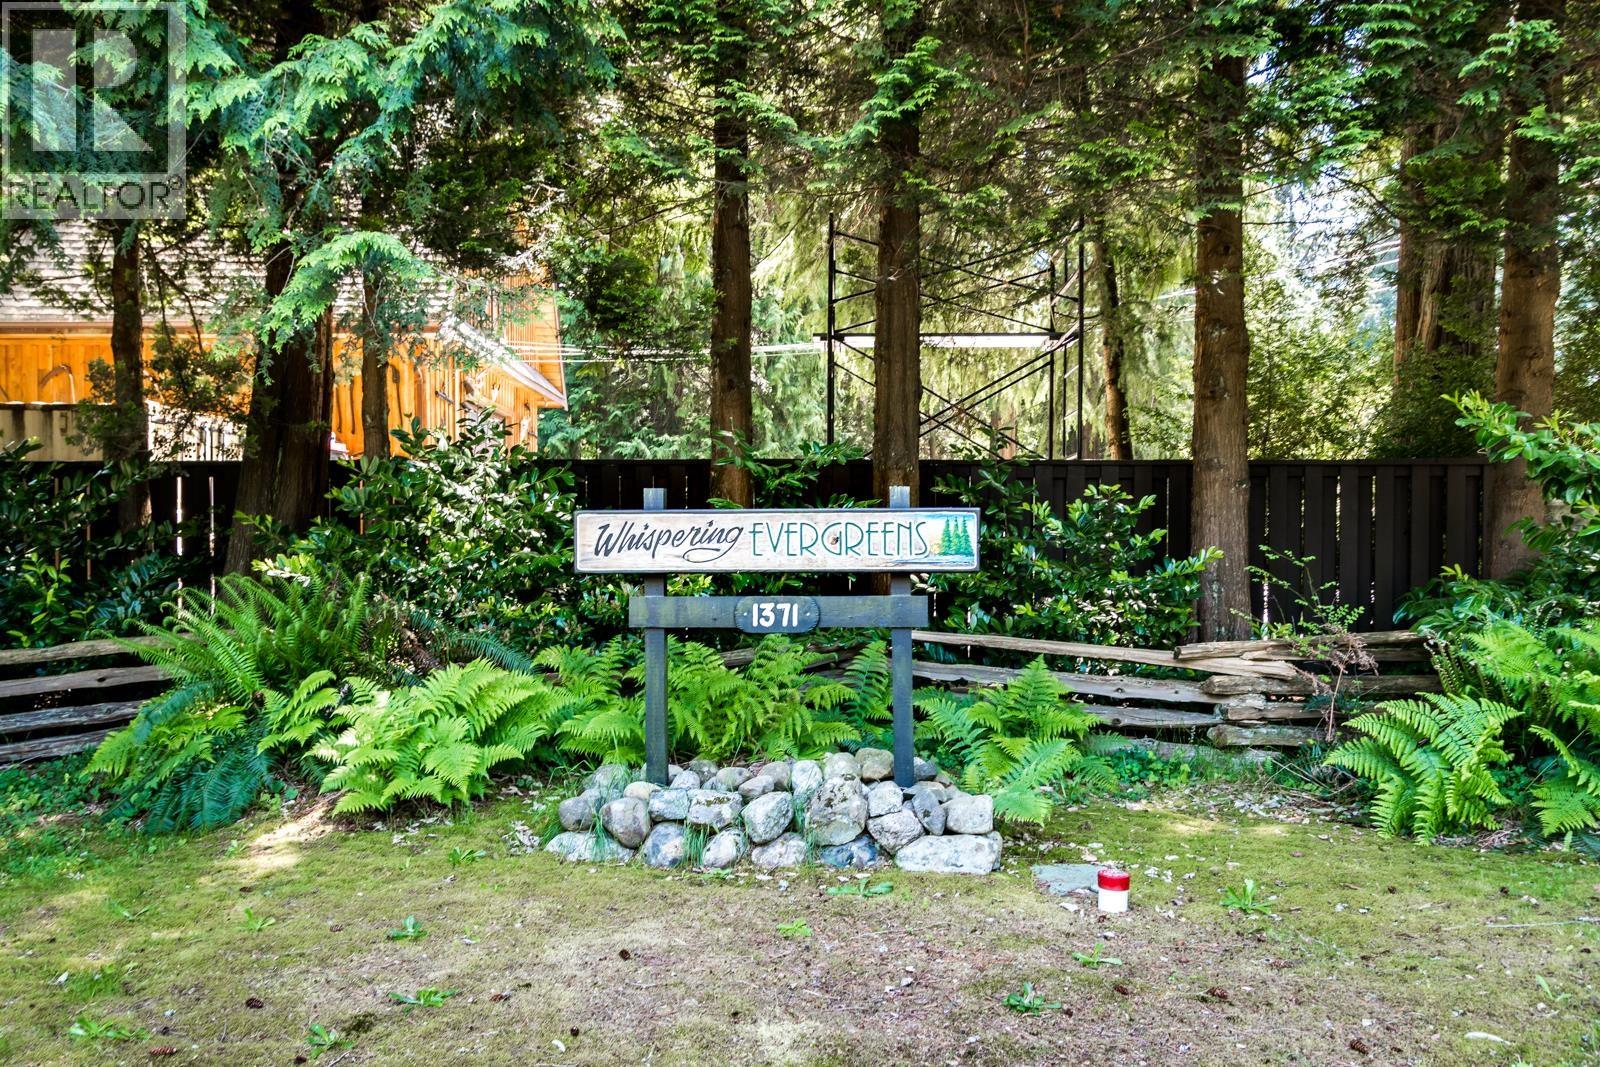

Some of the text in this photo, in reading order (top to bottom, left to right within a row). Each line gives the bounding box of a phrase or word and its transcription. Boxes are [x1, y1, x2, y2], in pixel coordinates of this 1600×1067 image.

[593, 519, 930, 564] Whispering EVERGREENS
[751, 602, 799, 627] 1371
